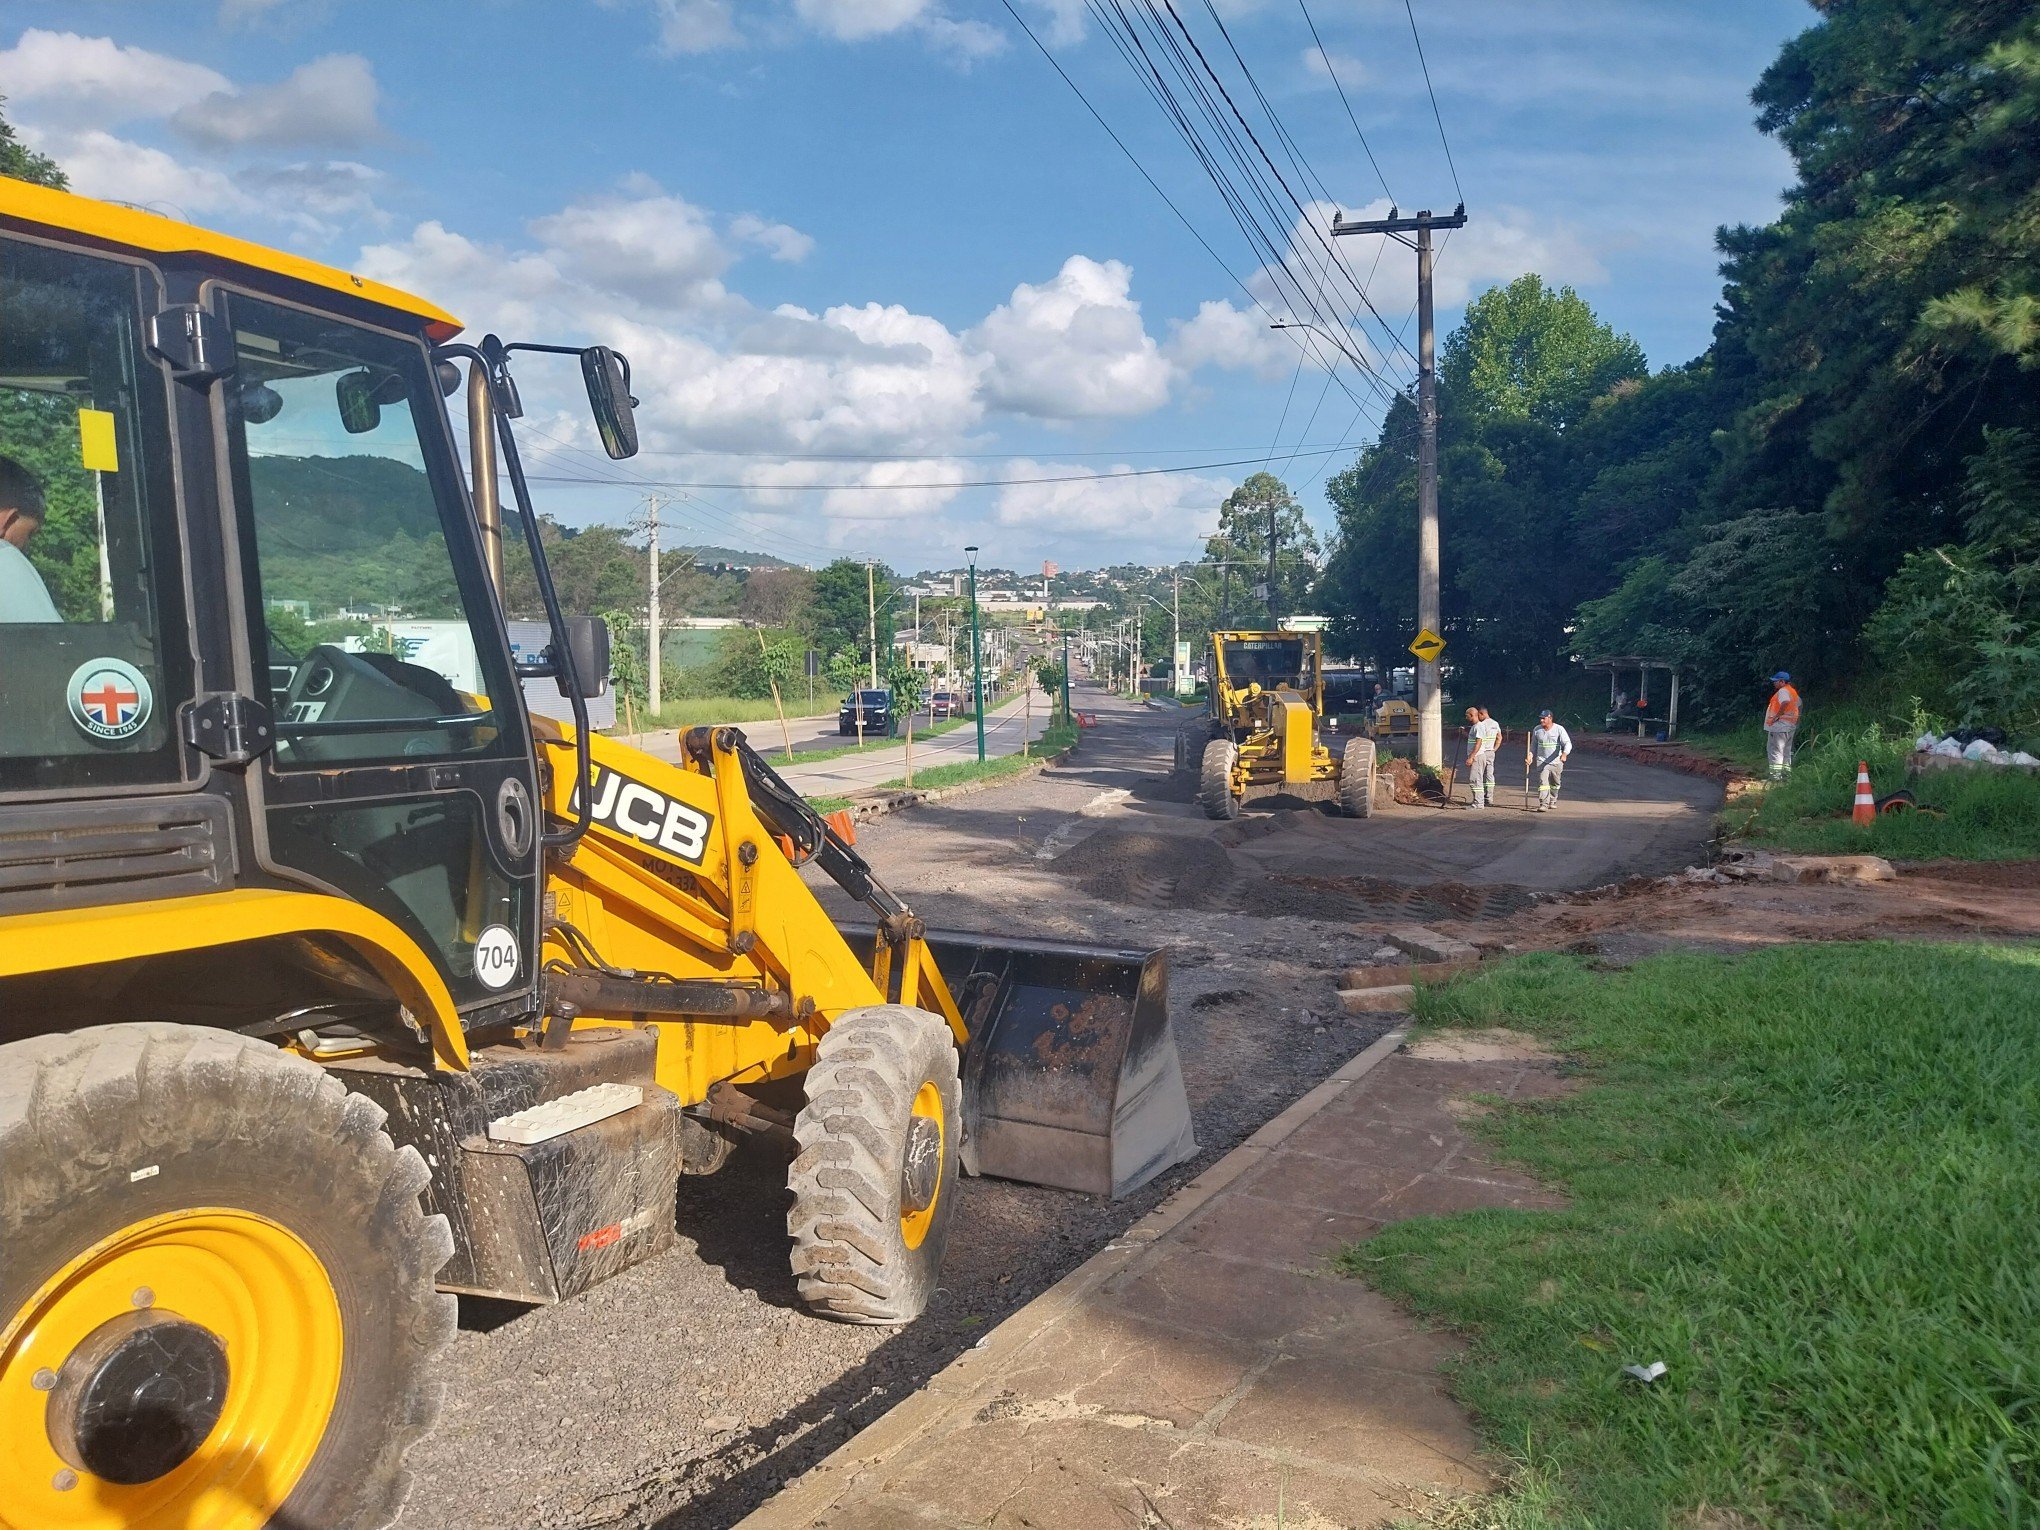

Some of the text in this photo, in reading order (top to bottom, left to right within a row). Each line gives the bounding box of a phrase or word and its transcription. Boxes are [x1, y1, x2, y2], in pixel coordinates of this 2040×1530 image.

[1243, 642, 1282, 650] CATERPILLAR
[88, 722, 137, 735] SINCE 1945
[574, 772, 707, 858] JCB
[480, 945, 515, 970] 704
